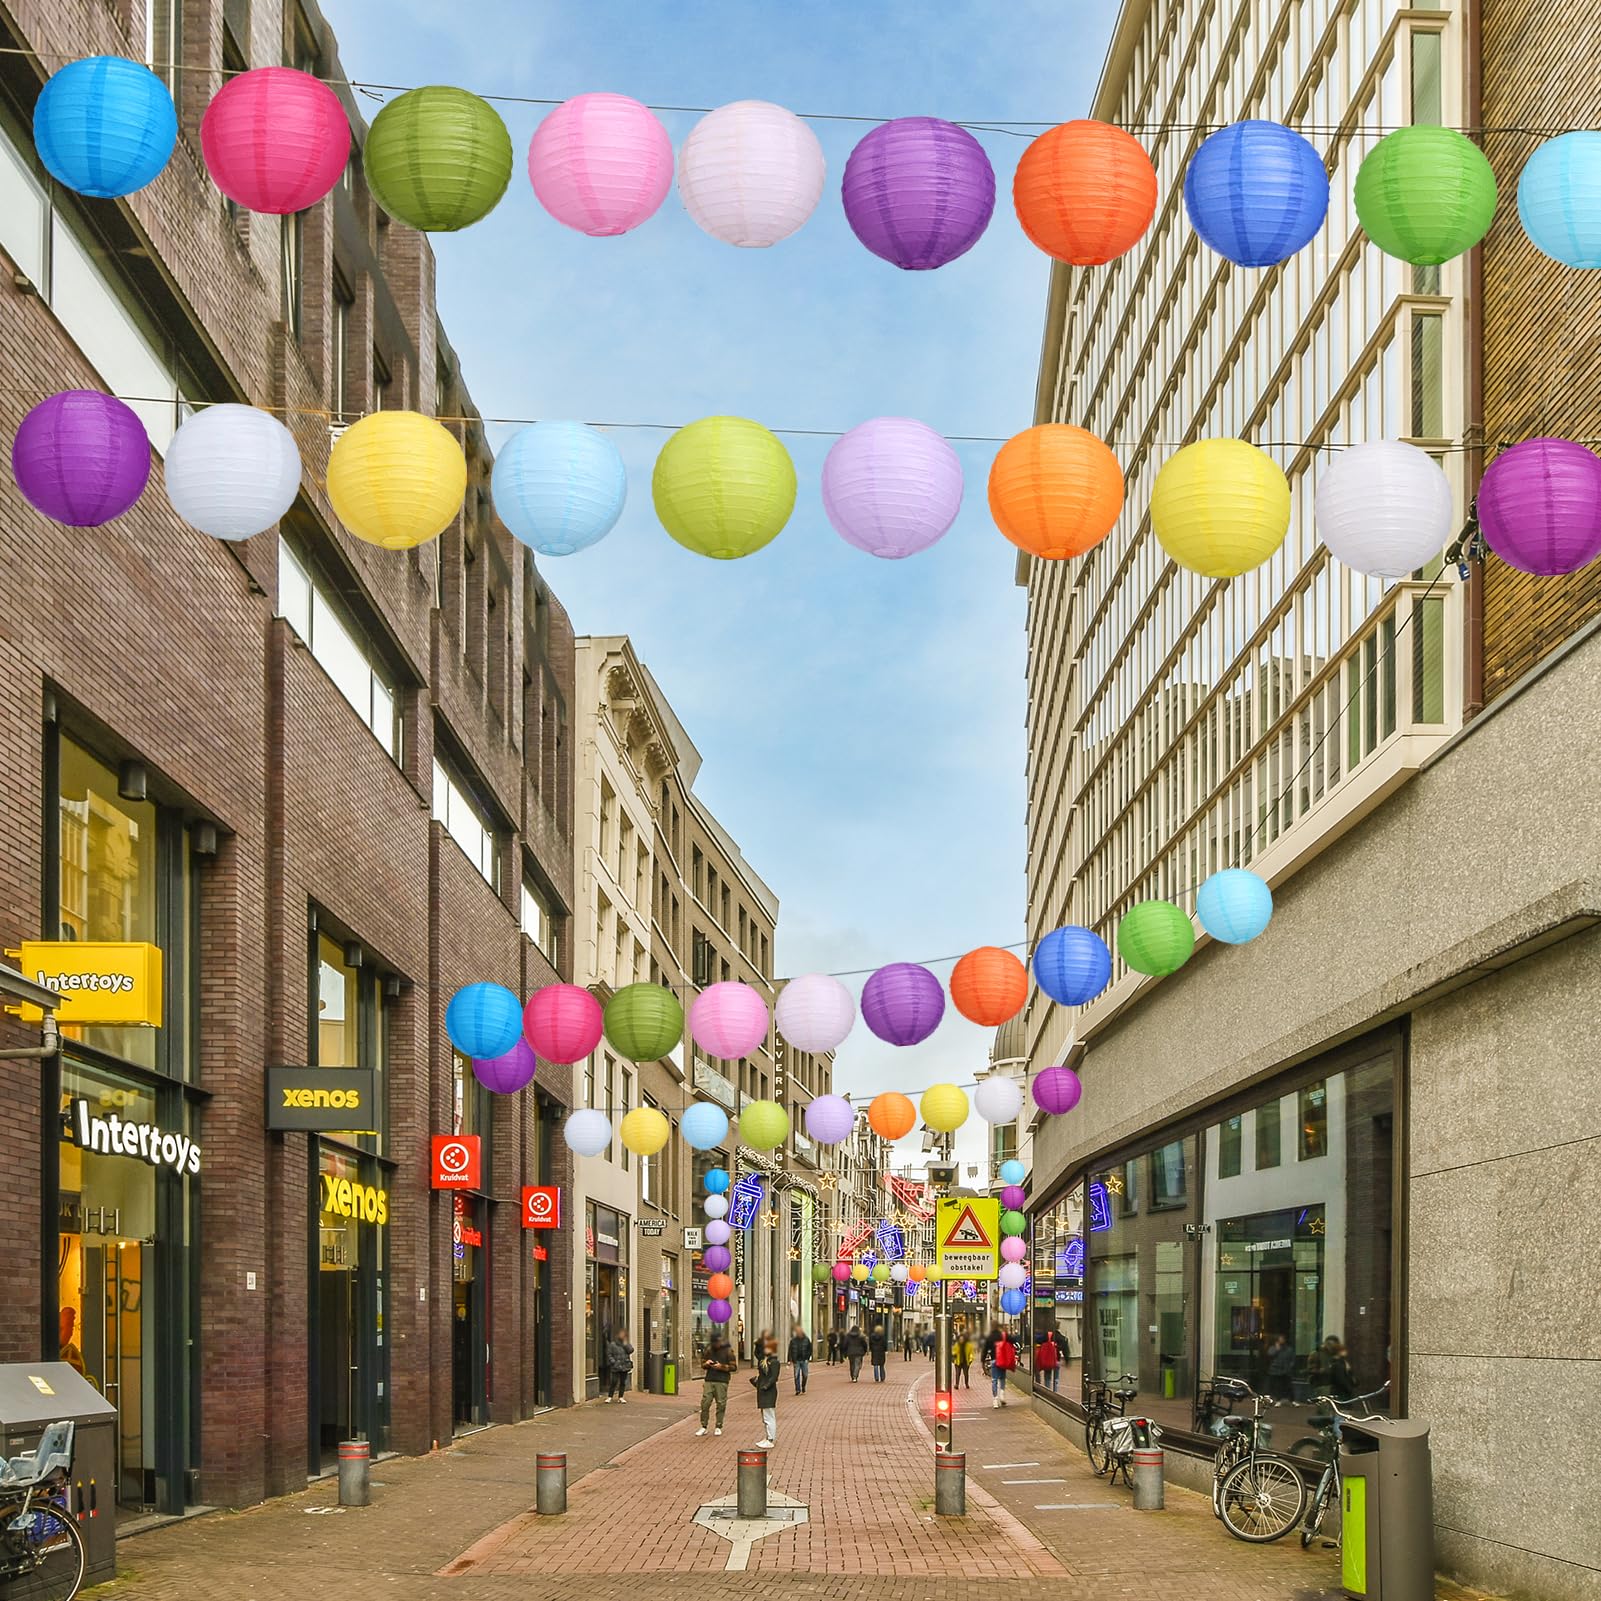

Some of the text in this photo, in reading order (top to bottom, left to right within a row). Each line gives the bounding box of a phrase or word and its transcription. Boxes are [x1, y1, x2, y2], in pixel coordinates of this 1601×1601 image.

[37, 971, 134, 993] Intertoys
[282, 1089, 359, 1108] xenos
[78, 1100, 201, 1174] Intertoys
[324, 1175, 386, 1225] xenos
[644, 1228, 660, 1236] TODAY
[944, 1254, 990, 1262] beweegbaar
